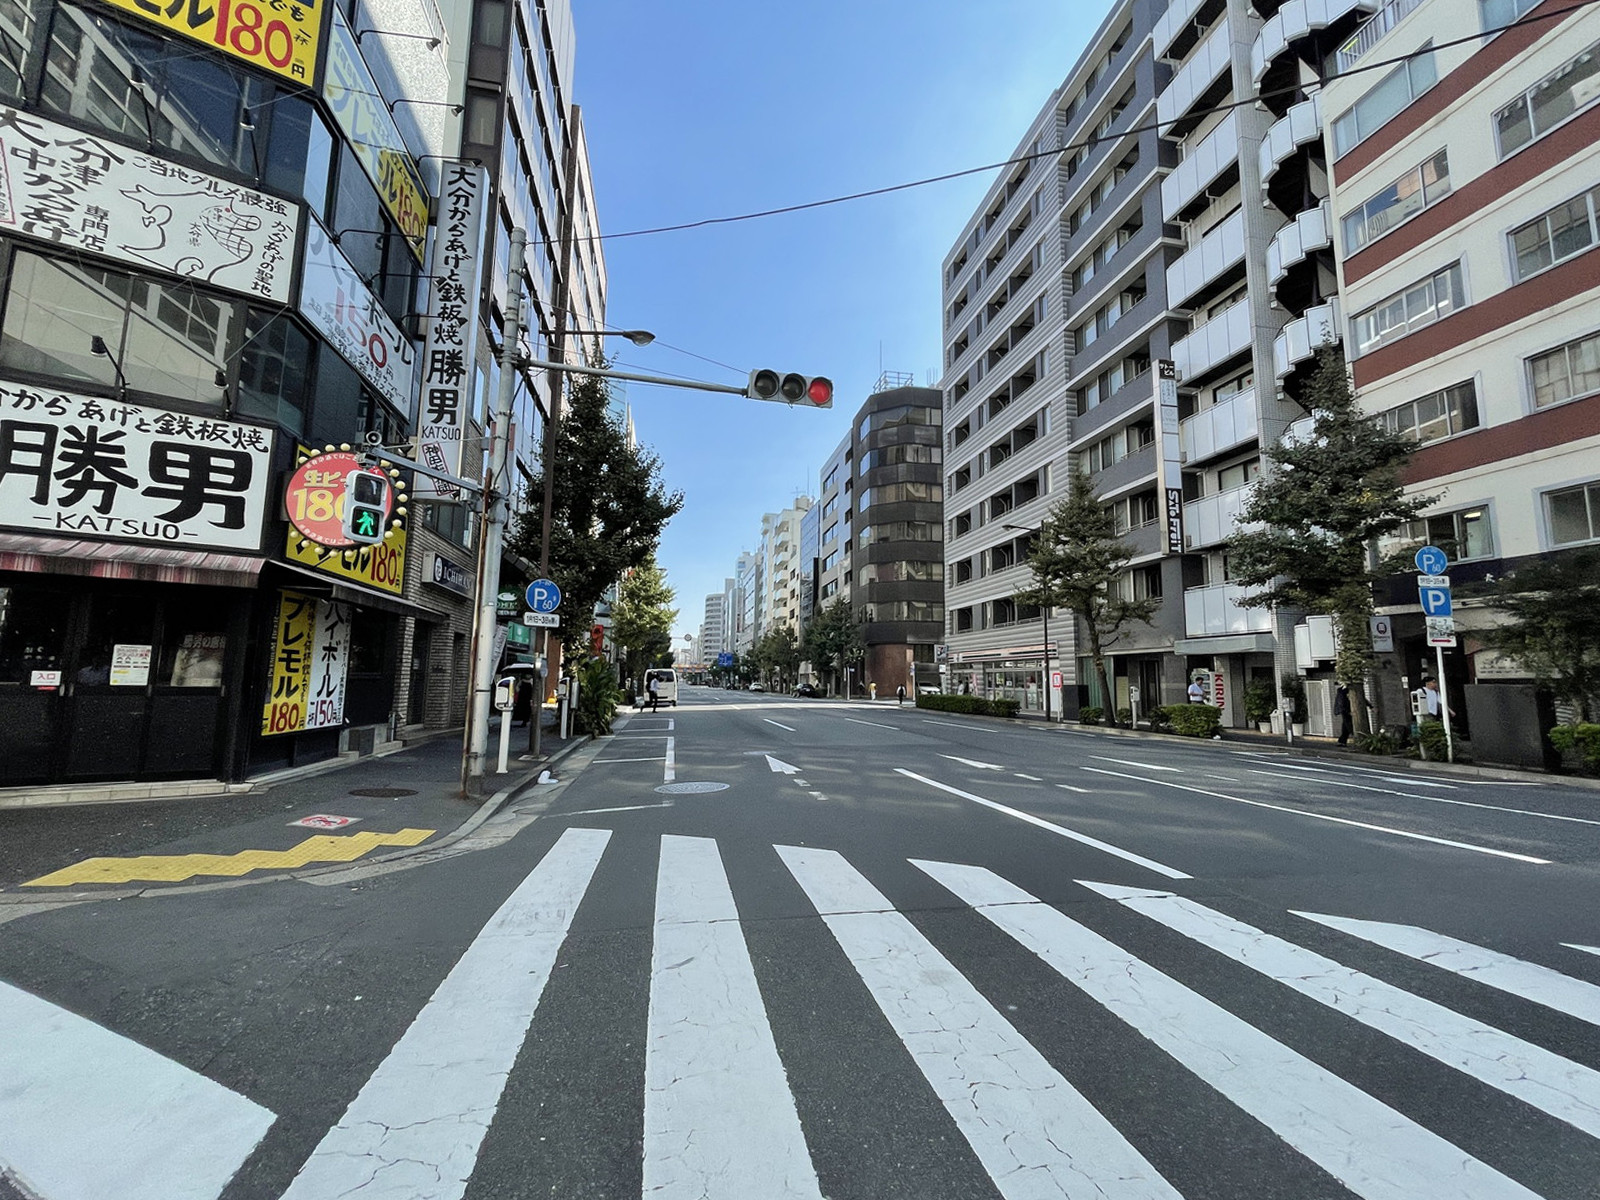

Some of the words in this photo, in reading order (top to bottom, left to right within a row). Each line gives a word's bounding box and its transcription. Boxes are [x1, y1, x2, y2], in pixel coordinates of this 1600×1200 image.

[214, 0, 293, 67] 180
[0, 109, 125, 172] 大分
[132, 155, 288, 217] ご当地グルメ最強
[251, 220, 293, 297] からあげの聖地
[434, 166, 477, 346] 大分からあげと鉄板焼
[334, 286, 388, 369] 150
[426, 348, 467, 426] 勝男
[421, 425, 462, 441] KATSUO
[0, 419, 253, 530] 勝男
[371, 542, 397, 586] 180
[1427, 589, 1446, 614] P
[36, 673, 56, 681] 入口
[317, 602, 344, 699] ハイボール
[269, 701, 300, 733] 180
[313, 699, 334, 727] 150
[1214, 673, 1225, 710] KIRIN
